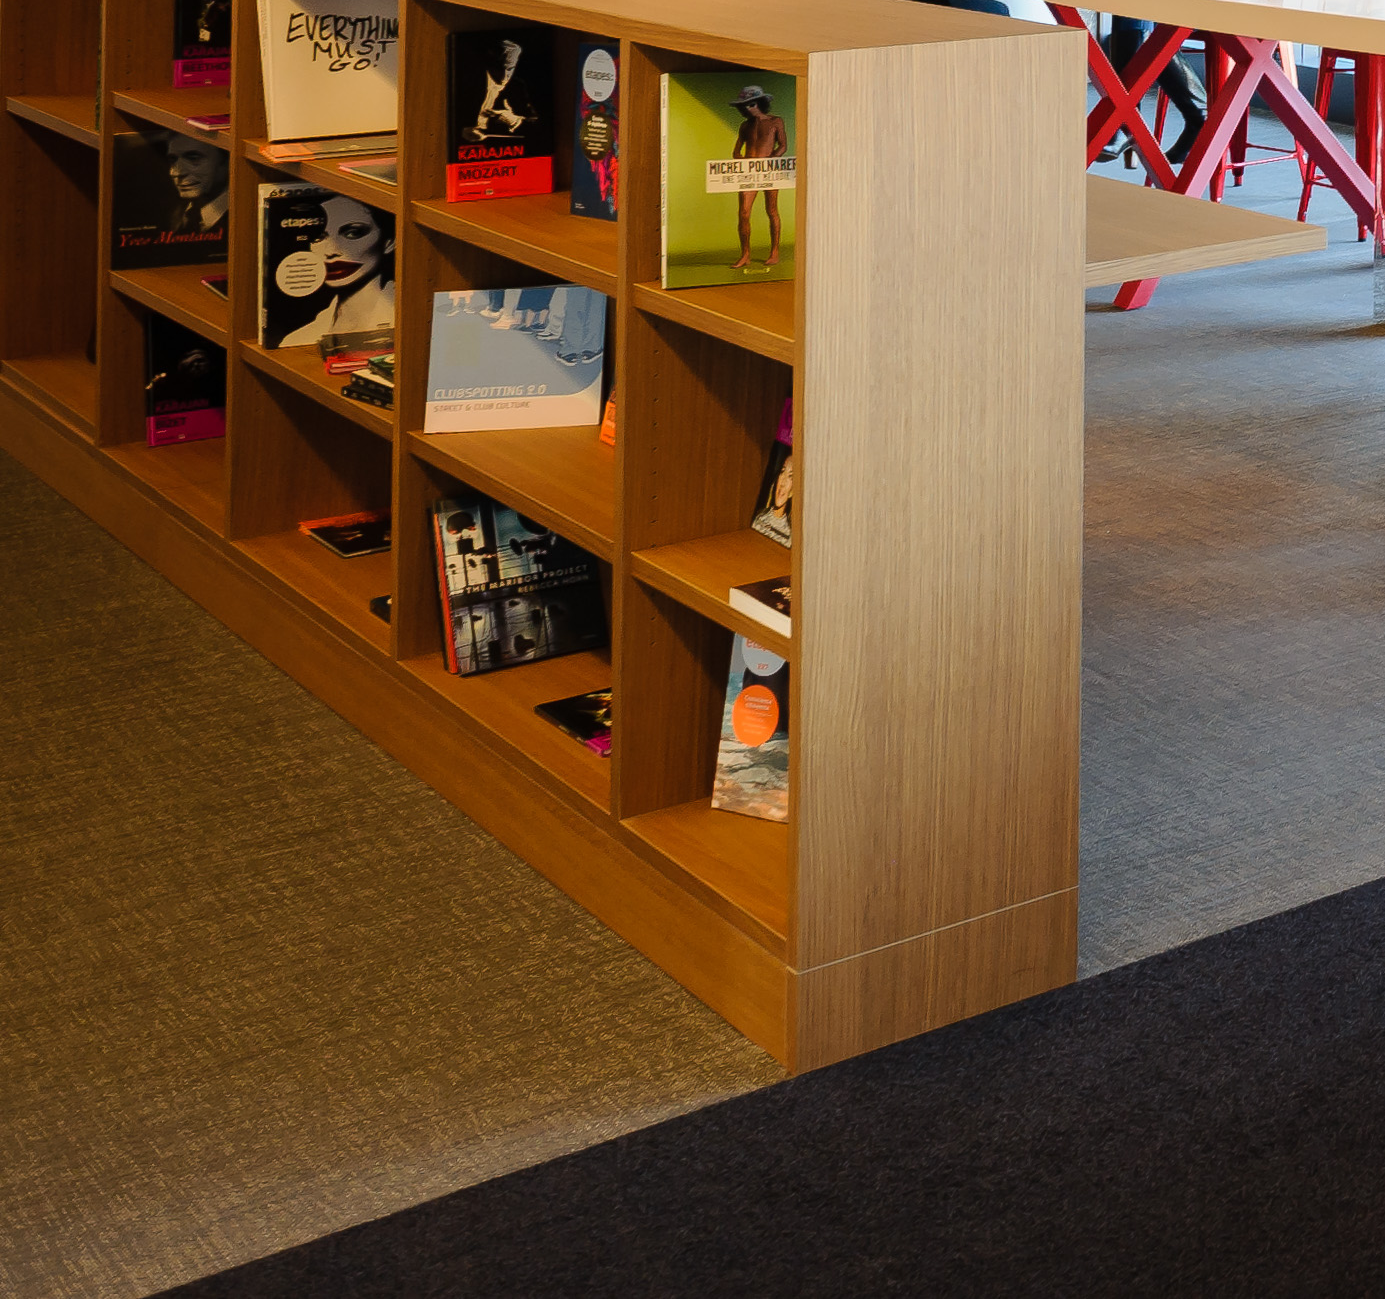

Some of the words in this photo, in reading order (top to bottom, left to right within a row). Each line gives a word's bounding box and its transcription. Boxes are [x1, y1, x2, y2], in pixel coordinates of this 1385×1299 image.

[287, 13, 398, 43] EVERYTHIN
[312, 39, 396, 62] MUST
[328, 52, 380, 72] GO!
[458, 145, 524, 161] KARAJAN
[458, 166, 517, 180] MOZART
[709, 162, 744, 175] MICHEL
[120, 233, 151, 248] Yves
[153, 227, 223, 245] Montand
[434, 385, 524, 400] CLUBSPOTTING
[155, 417, 186, 430] BIZET
[466, 585, 486, 595] THE
[489, 574, 539, 590] MARIBOR
[542, 564, 588, 579] PROJECT
[517, 581, 558, 594] REBECCA
